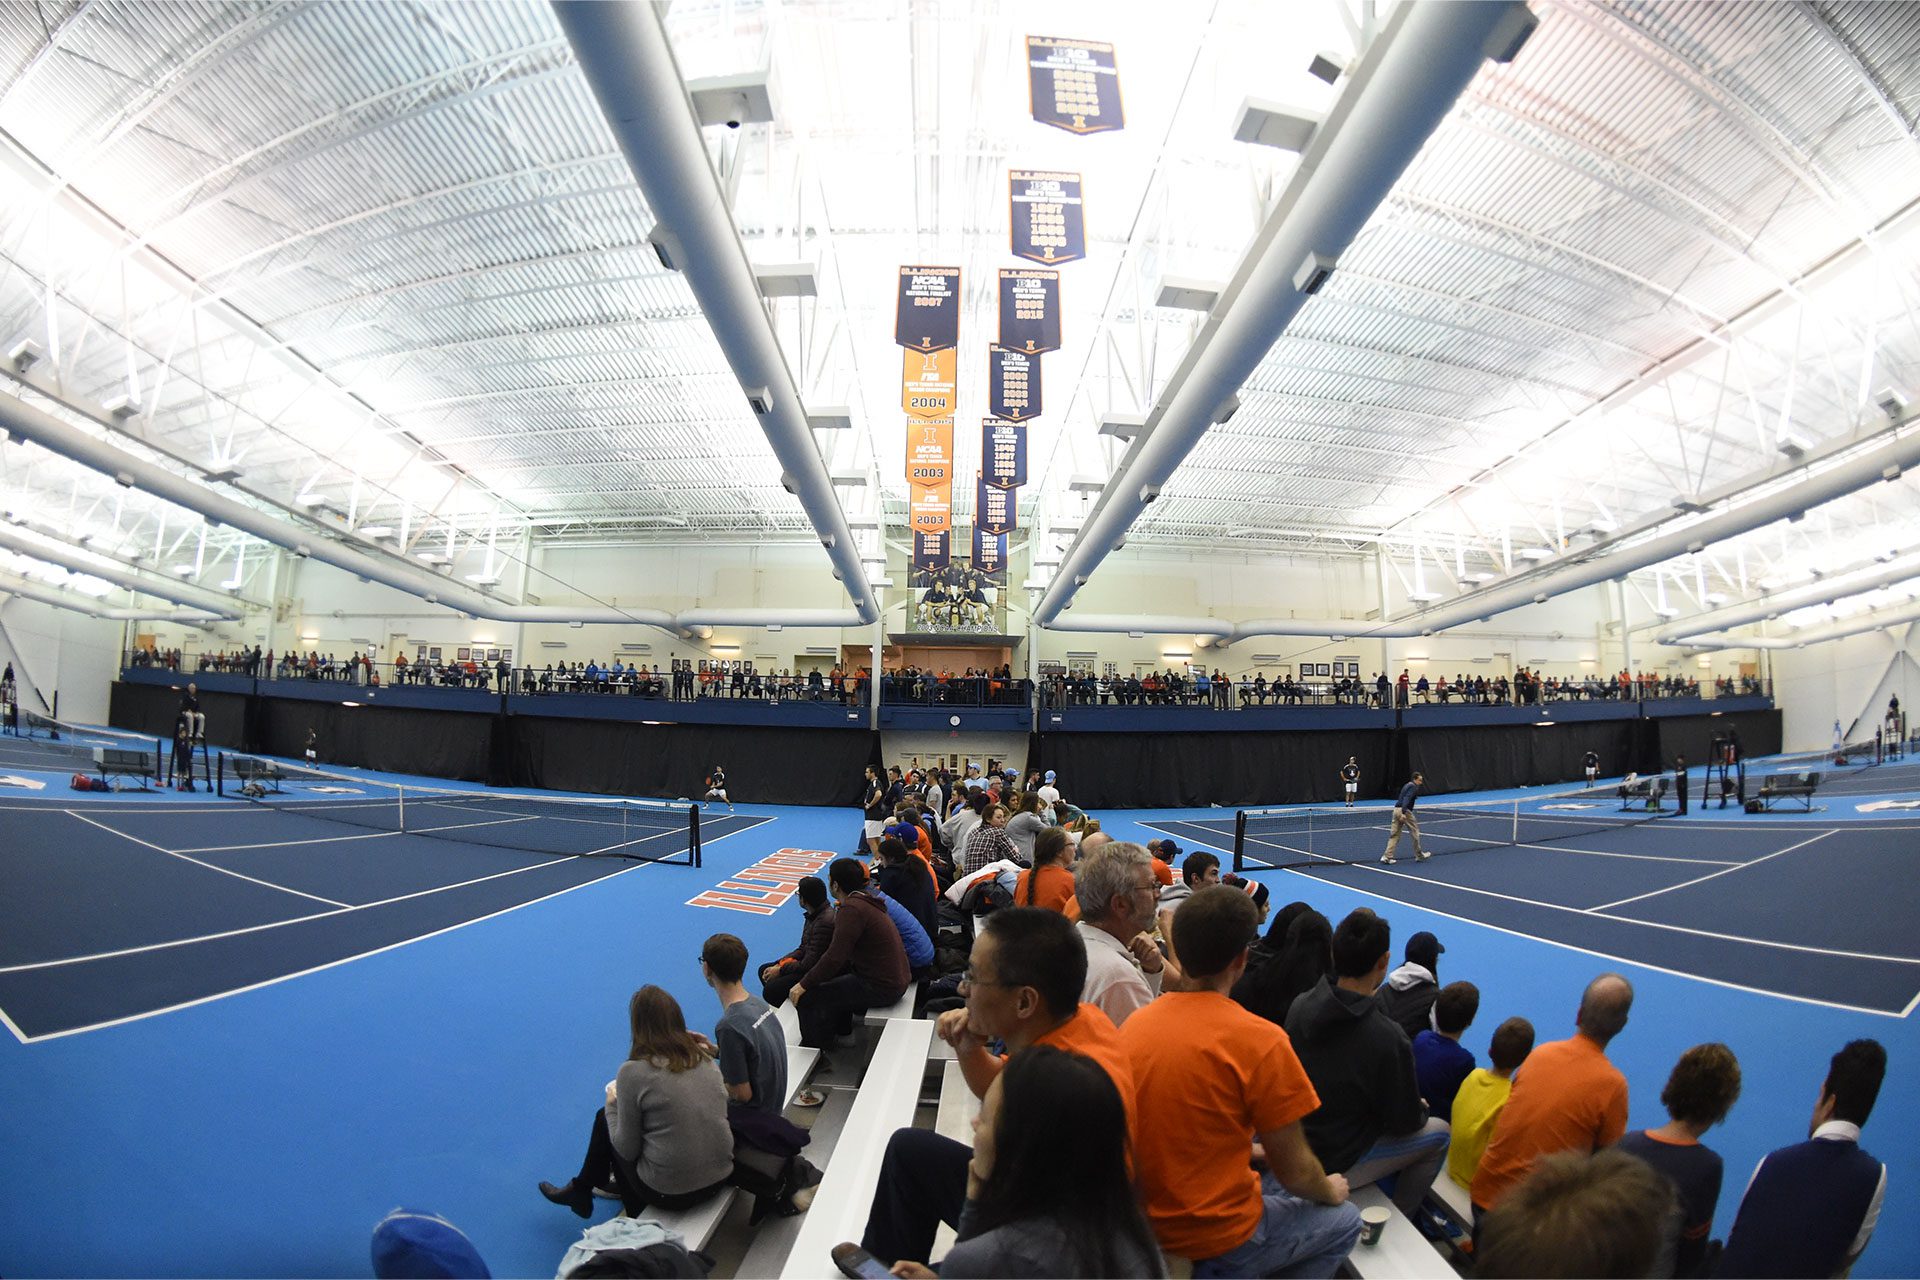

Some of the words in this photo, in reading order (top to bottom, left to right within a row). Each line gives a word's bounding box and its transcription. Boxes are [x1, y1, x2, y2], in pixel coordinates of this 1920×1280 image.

[912, 276, 946, 285] NCAA
[911, 398, 946, 408] 2004
[914, 468, 944, 477] 2003
[684, 848, 837, 915] ILLINOIS
